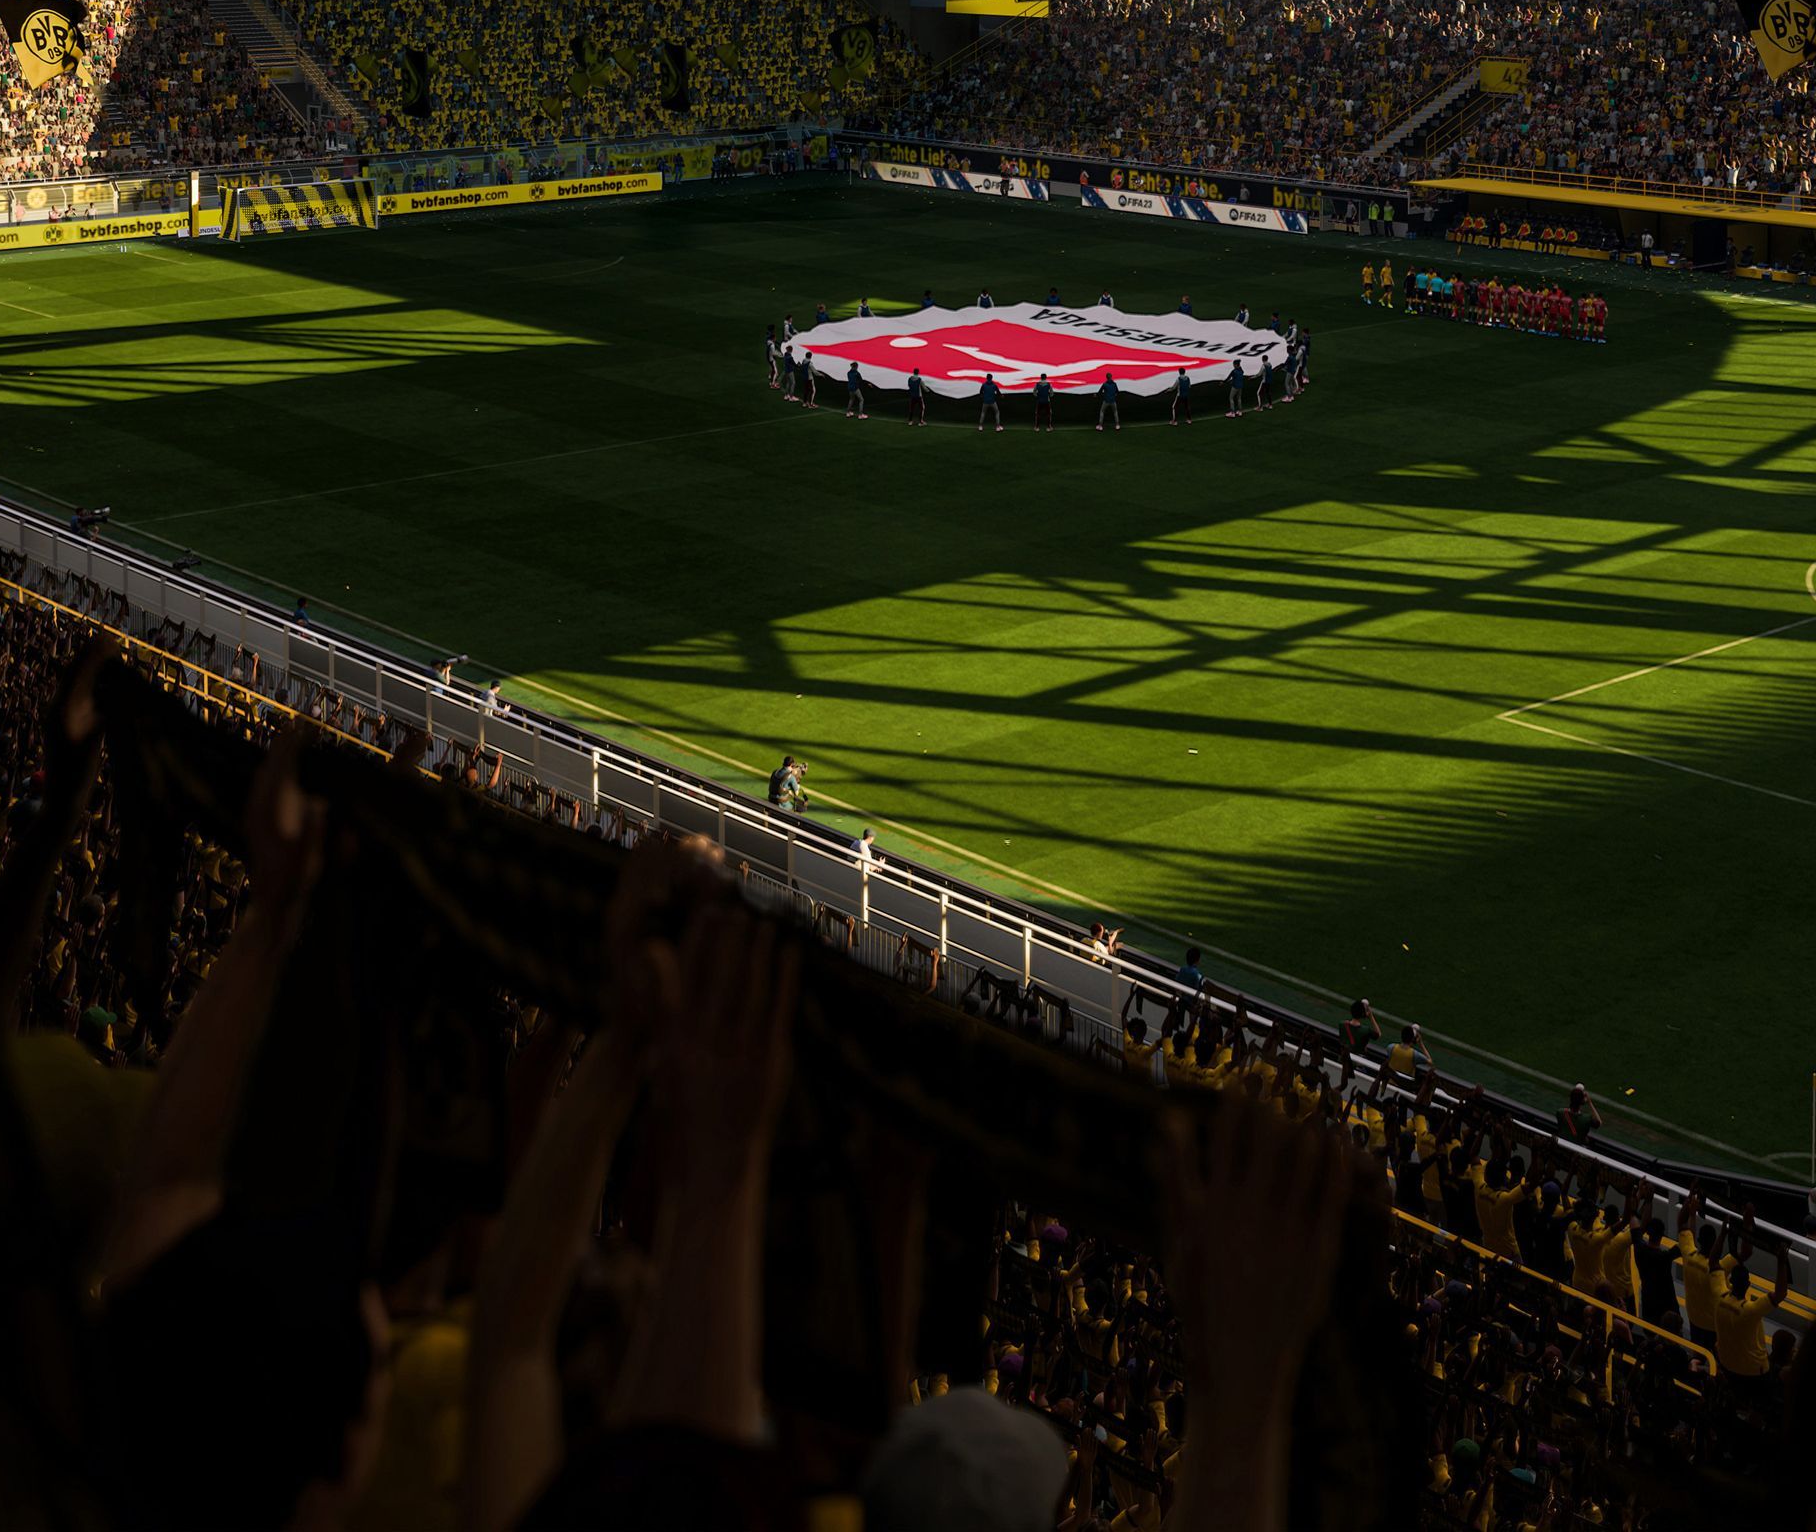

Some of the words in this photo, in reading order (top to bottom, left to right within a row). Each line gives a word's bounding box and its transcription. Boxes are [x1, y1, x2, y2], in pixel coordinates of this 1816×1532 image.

[1770, 2, 1810, 39] BVB
[31, 16, 69, 51] BVB
[558, 177, 648, 196] bvbfanshop.com
[411, 190, 509, 209] bvbfanshop.com
[1128, 197, 1143, 207] FIFA
[1143, 200, 1153, 209] 23
[1239, 211, 1255, 221] FIFA
[1255, 214, 1267, 223] 23
